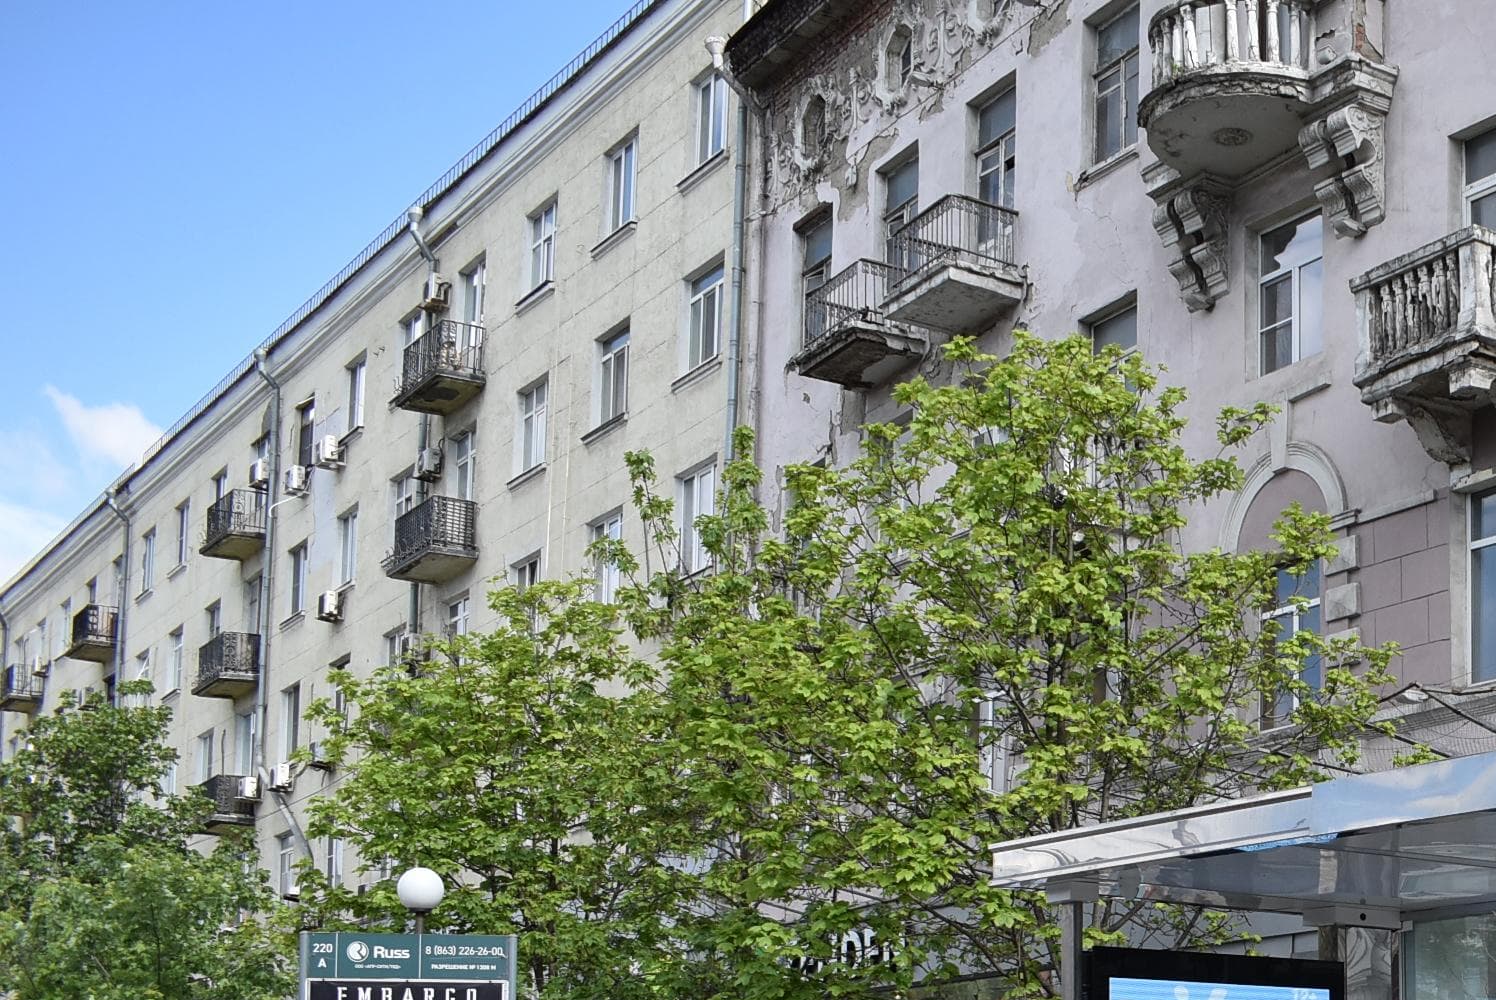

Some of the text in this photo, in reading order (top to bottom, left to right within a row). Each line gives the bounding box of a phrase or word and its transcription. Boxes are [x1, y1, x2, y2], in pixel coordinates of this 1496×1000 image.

[312, 943, 333, 953] 220
[373, 945, 411, 959] Russ
[425, 945, 503, 956] 8 (863) 226-26-00
